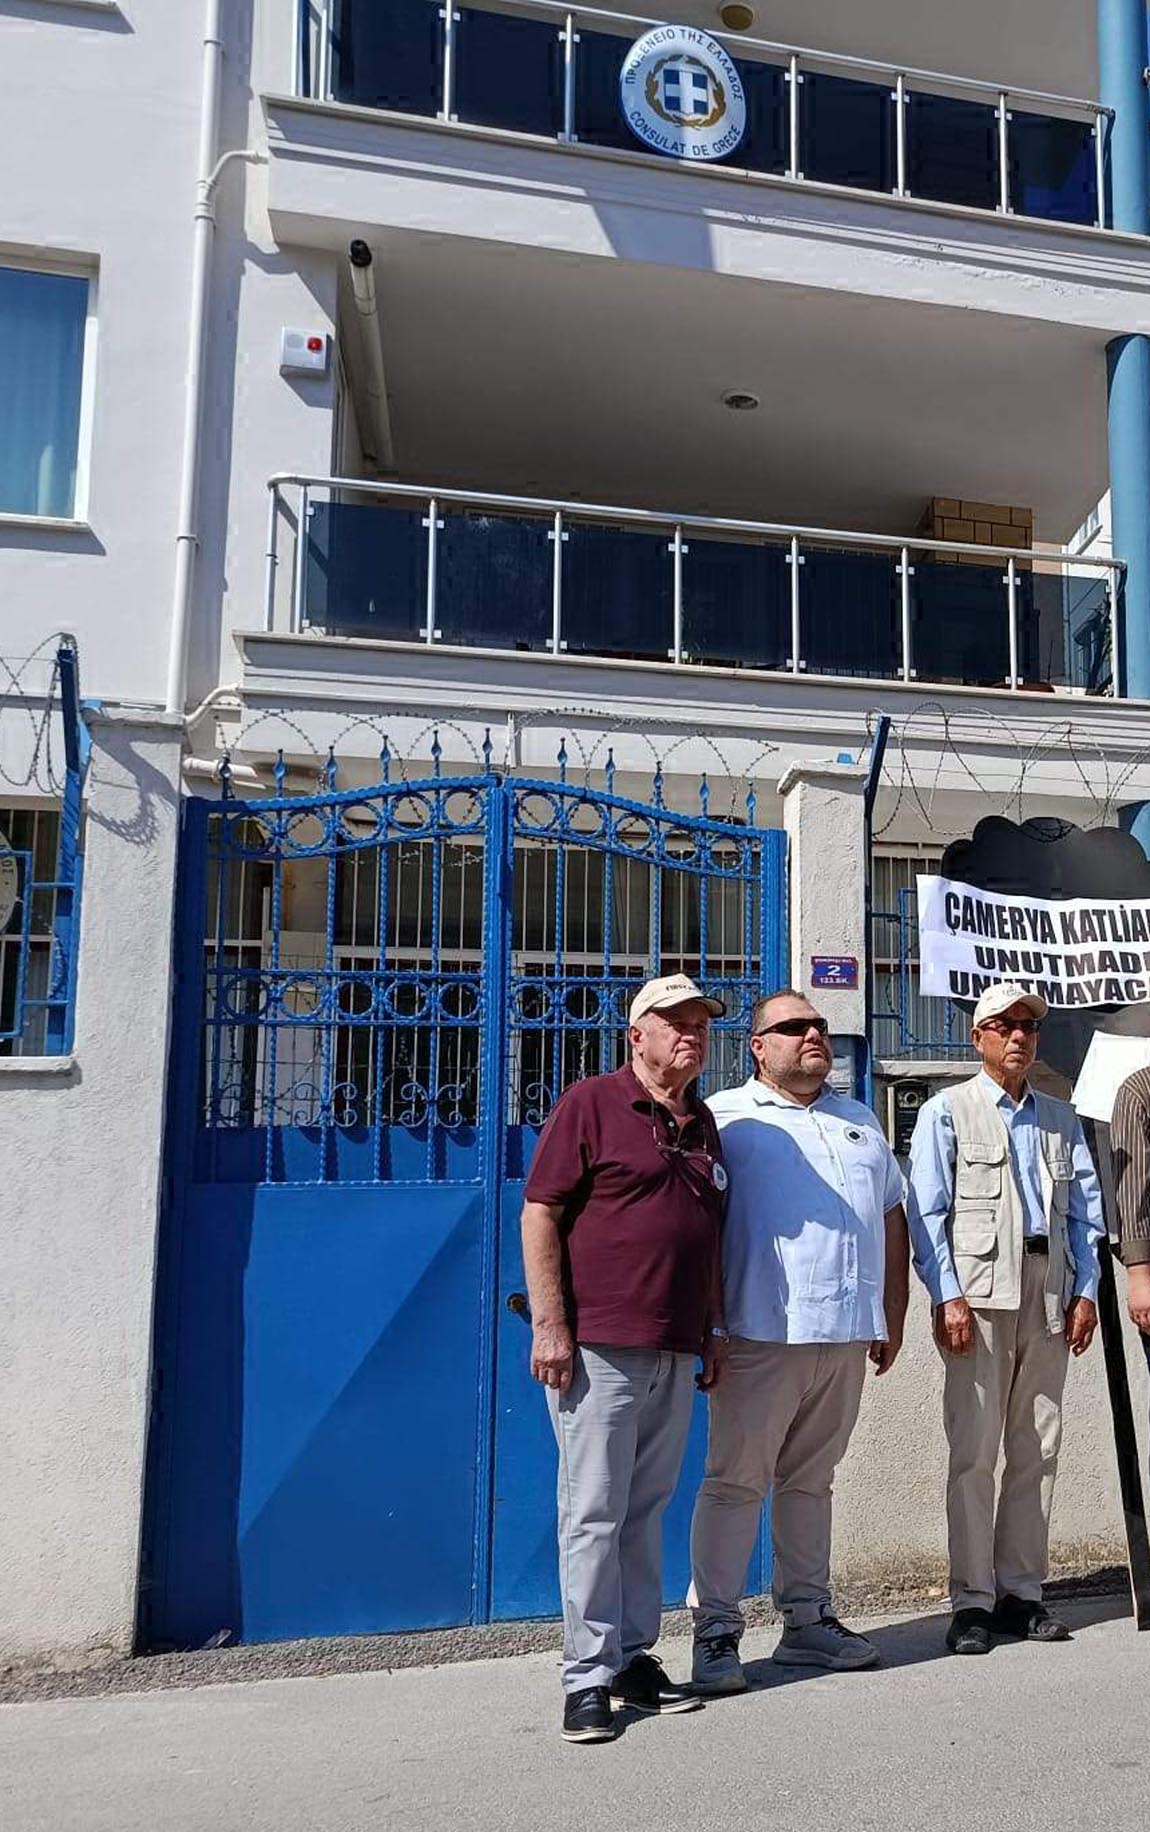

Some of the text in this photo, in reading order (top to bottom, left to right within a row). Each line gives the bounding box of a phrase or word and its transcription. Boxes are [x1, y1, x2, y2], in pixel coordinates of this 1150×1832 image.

[680, 28, 704, 45] ΤΗΣ
[706, 41, 743, 102] ΕΛΛΑΔΟΣ
[629, 111, 741, 156] CONSULAT DE GRECE
[945, 892, 1056, 944] ÇAMERYA
[827, 965, 841, 976] 2
